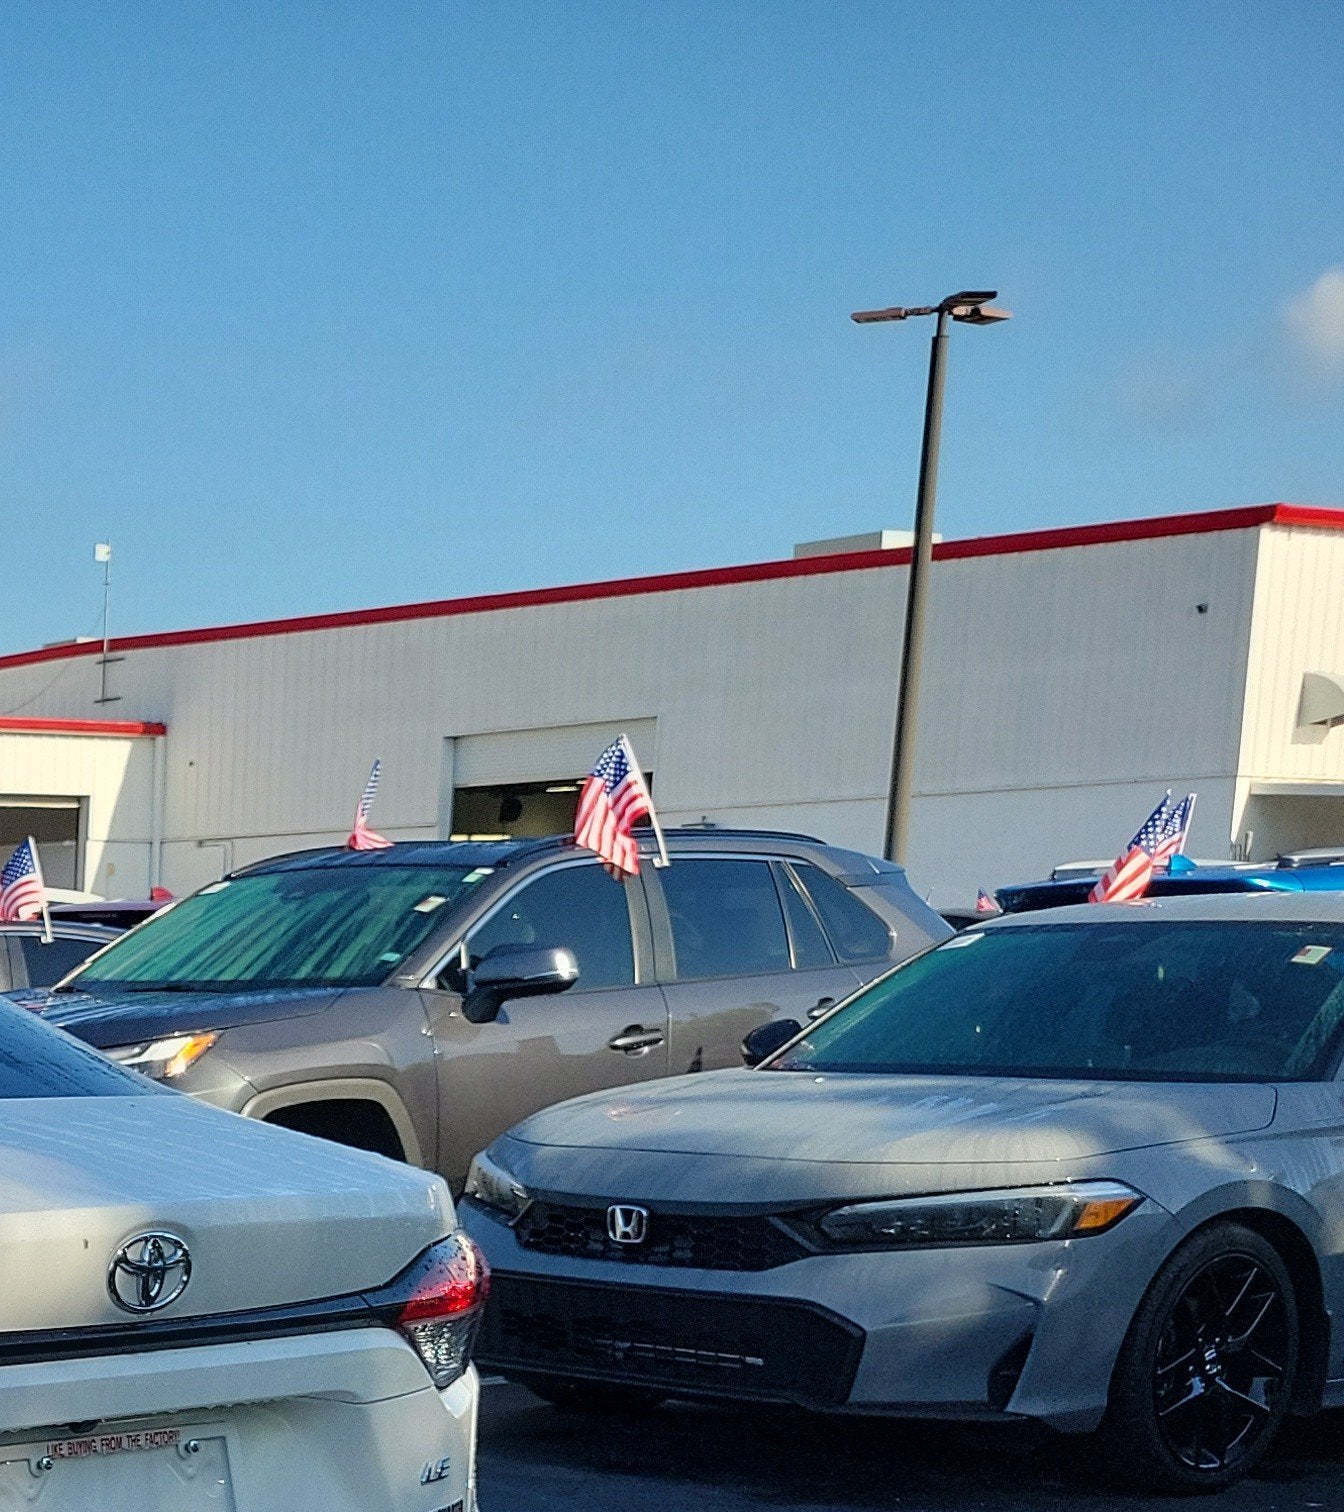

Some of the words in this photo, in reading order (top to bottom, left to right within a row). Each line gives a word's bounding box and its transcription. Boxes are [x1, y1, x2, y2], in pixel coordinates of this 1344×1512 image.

[46, 1443, 64, 1458] LIKE
[67, 1438, 97, 1456] BUYING
[100, 1435, 123, 1452] FROM
[126, 1432, 141, 1448] THE
[420, 1456, 450, 1486] LE
